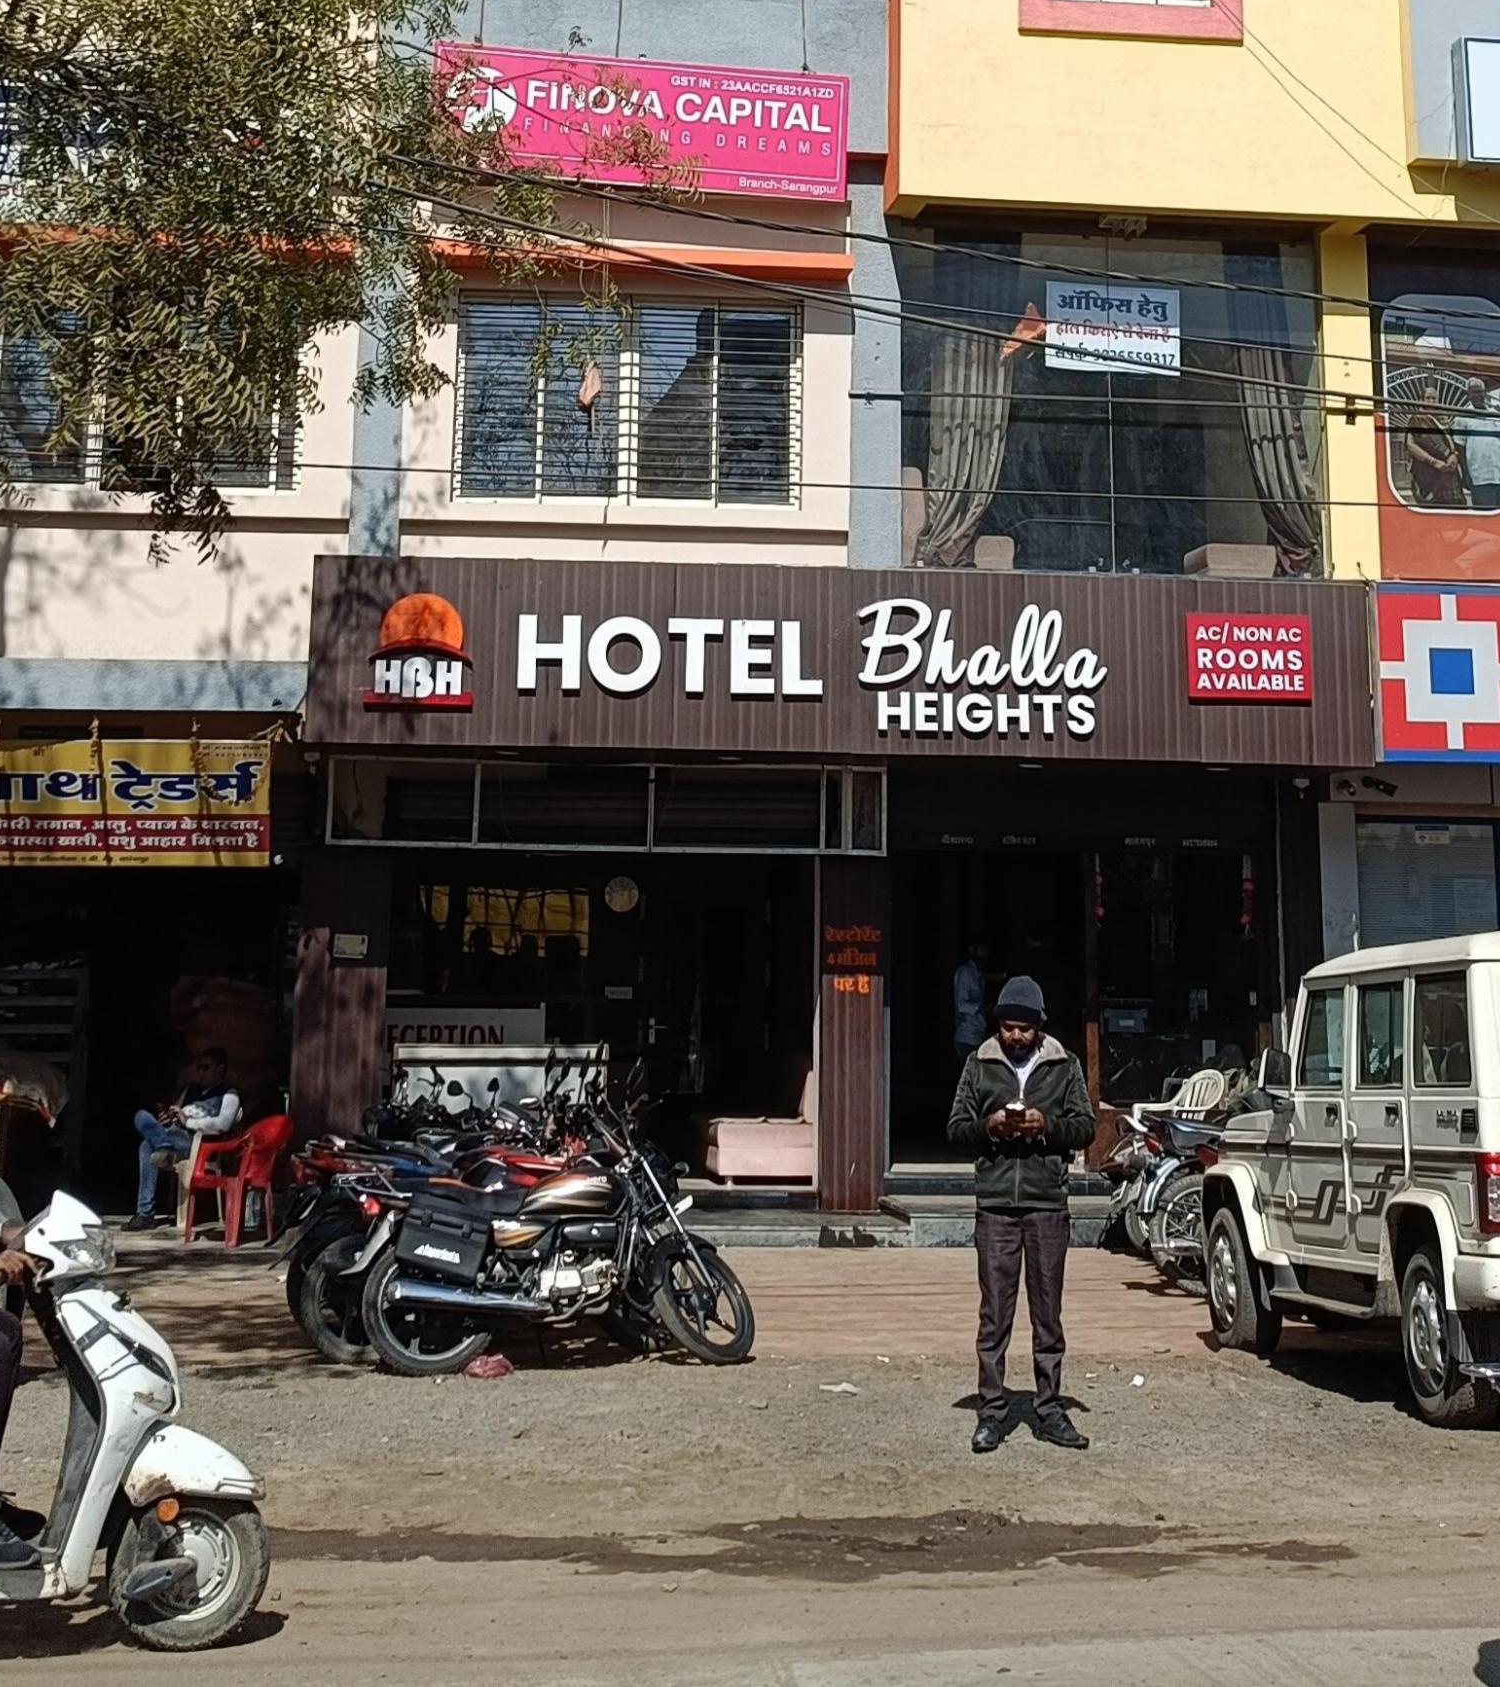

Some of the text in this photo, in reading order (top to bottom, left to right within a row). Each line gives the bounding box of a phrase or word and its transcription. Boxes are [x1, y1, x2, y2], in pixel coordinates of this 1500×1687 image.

[670, 75, 697, 88] GST
[674, 92, 832, 134] CAPITAL
[522, 117, 832, 157] FINANCNG DREAMS
[738, 176, 838, 196] Branch-Sarangpur
[1057, 289, 1169, 323] ऑफिस हेतु
[857, 598, 1108, 690] Bhalla
[1233, 626, 1271, 643] NON
[1275, 628, 1303, 644] AC
[517, 614, 823, 696] HOTEL
[1197, 648, 1304, 671] ROOMS
[1197, 672, 1306, 693] AVAILABLE
[877, 692, 1097, 737] HEIGHTS
[112, 759, 265, 810] ट्रेडर्स
[136, 819, 177, 830] प्याज
[180, 817, 197, 830] के
[245, 831, 259, 847] है
[834, 976, 855, 992] पर
[386, 1022, 505, 1047] ECEPTION
